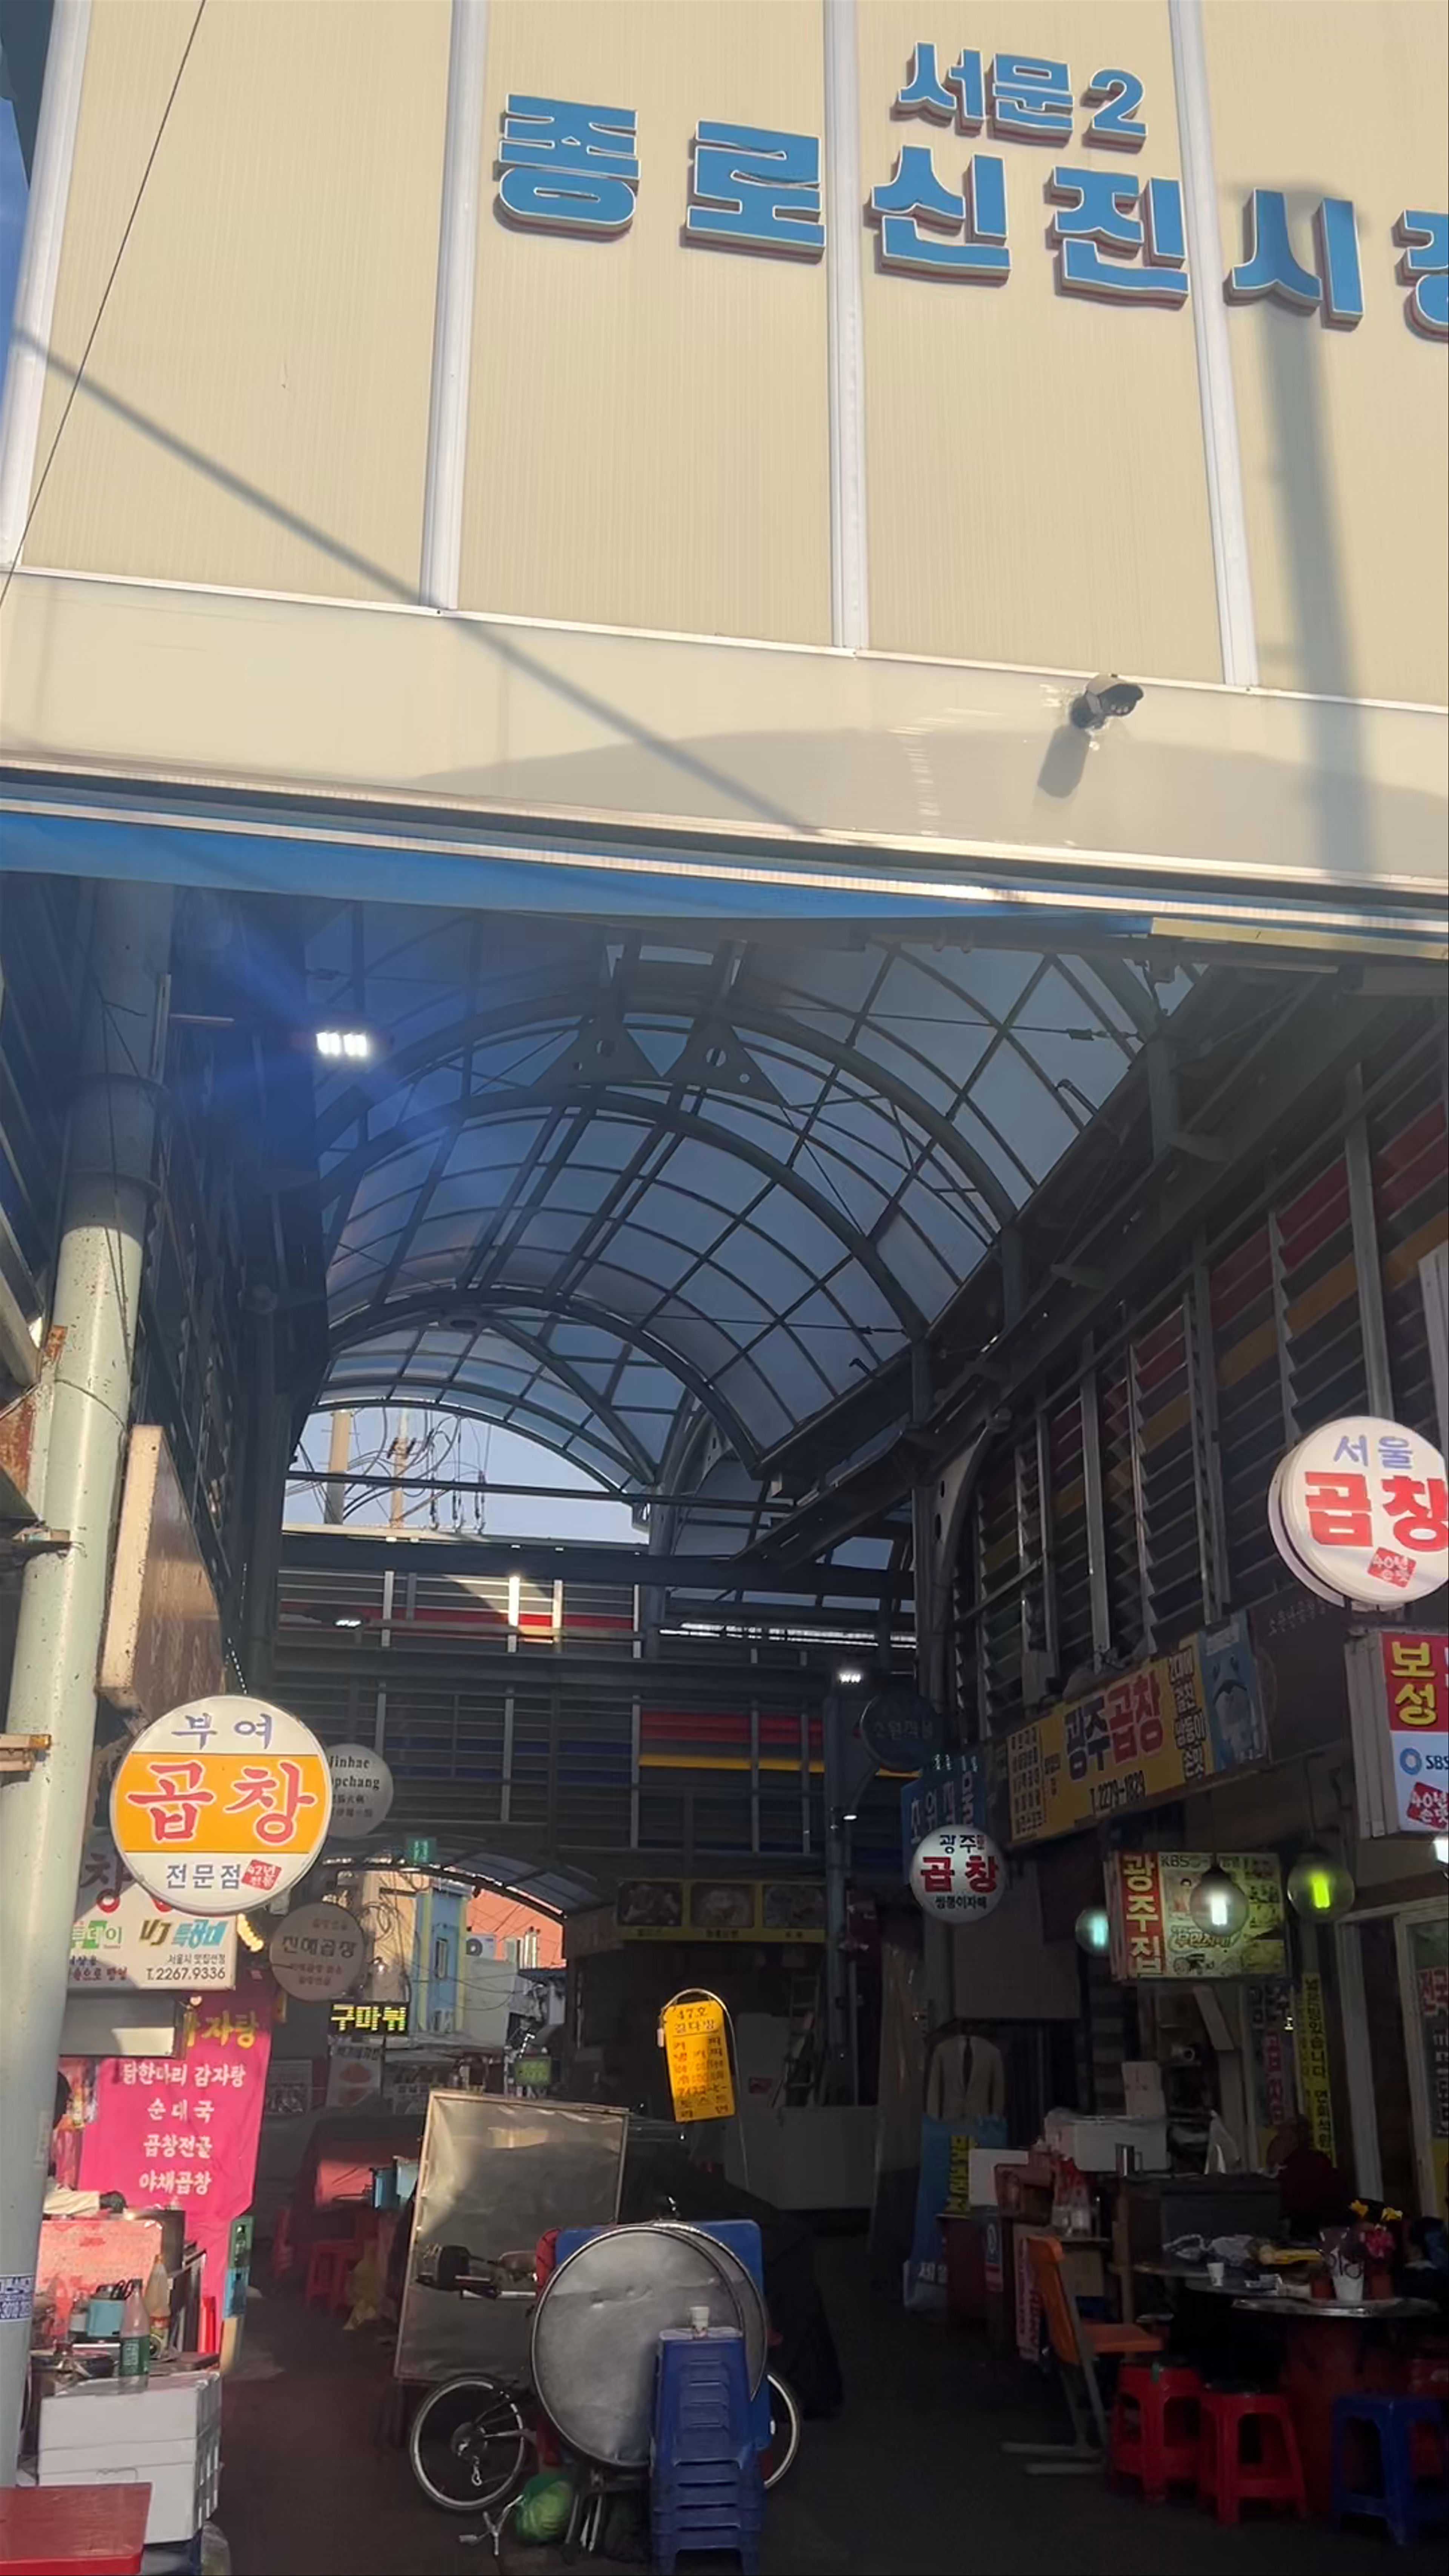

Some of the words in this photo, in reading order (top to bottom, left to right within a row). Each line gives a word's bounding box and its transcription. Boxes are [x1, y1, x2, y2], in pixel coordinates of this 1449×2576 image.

[891, 41, 1148, 153] 서문2
[1333, 1435, 1413, 1469] 서울
[1305, 1471, 1449, 1552] 곱창
[1391, 1641, 1437, 1726] 보성
[171, 1712, 273, 1750] 부여
[1425, 1755, 1449, 1770] SBS
[331, 1776, 380, 1791] pchang
[126, 1759, 316, 1845] 곱창
[920, 1856, 998, 1893] 곱창
[1160, 1855, 1189, 1868] KBS
[166, 1863, 242, 1890] 전문점
[146, 1967, 226, 1980] T.2267.9336
[123, 2062, 188, 2086] 닭한마리
[193, 2063, 247, 2089] 감자탕
[148, 2099, 215, 2123] 순대국
[143, 2134, 213, 2159] 곱창전골
[139, 2171, 212, 2195] 야채곱창
